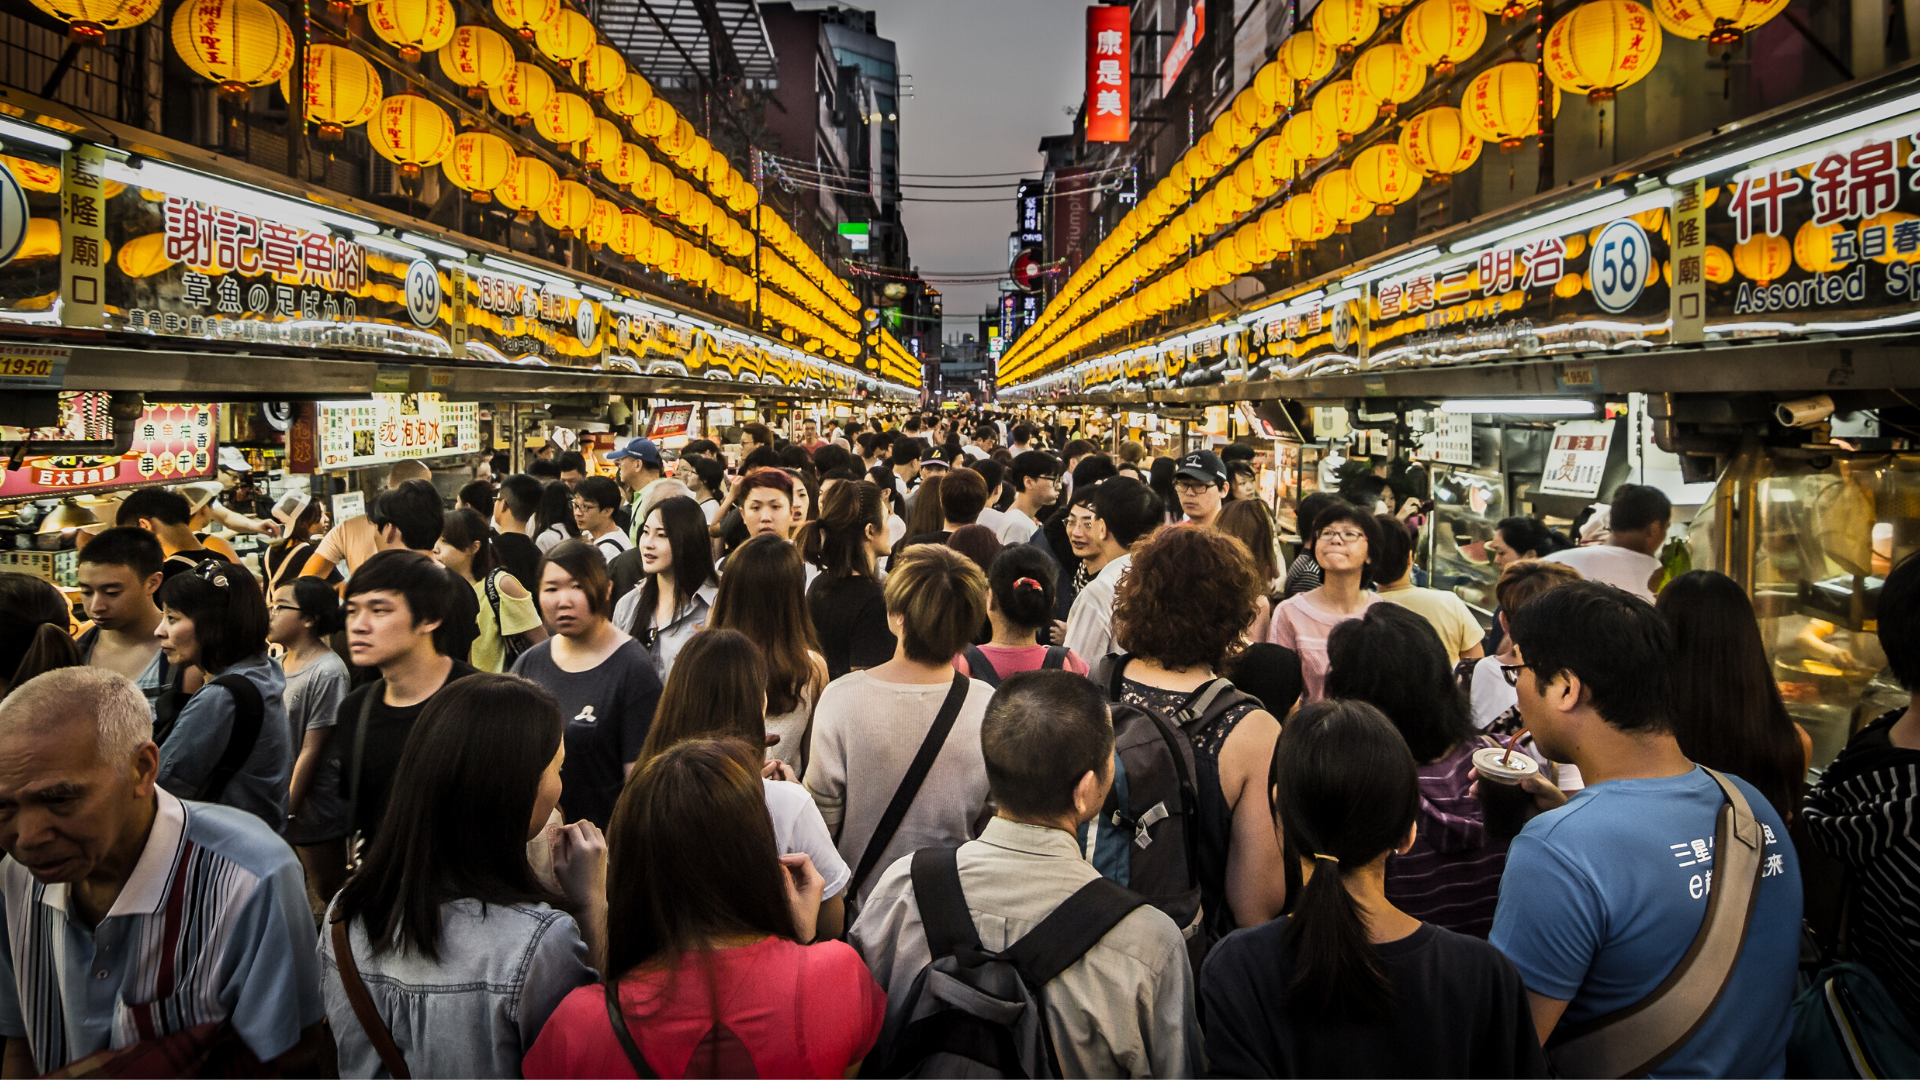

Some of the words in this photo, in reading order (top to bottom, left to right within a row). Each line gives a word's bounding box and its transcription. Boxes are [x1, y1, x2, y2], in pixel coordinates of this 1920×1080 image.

[1620, 3, 1646, 71] 歡迎光臨
[1096, 29, 1122, 116] 康是美
[386, 106, 405, 150] 開漳聖王
[1385, 148, 1400, 192] 歡迎光臨
[1729, 130, 1920, 244] 什錦
[71, 155, 99, 305] 基隆廟口
[165, 195, 366, 293] 謝記章魚腳
[1676, 182, 1700, 320] 基隆廟口
[1379, 239, 1565, 318] 營養三明治
[1602, 235, 1637, 296] 58
[183, 271, 356, 325] 章魚の足ばかり
[414, 271, 435, 315] 39
[479, 275, 520, 314] 泡泡冰
[1734, 265, 1866, 315] Assorted
[502, 334, 540, 353] Pao-Pao
[581, 310, 592, 341] 37
[1335, 310, 1348, 341] 56
[2, 358, 49, 375] 1950
[142, 403, 157, 474] 魚串
[401, 418, 440, 447] 泡泡冰
[1669, 836, 1716, 868] 三星
[1689, 869, 1713, 899] e
[1762, 853, 1785, 878] 來
